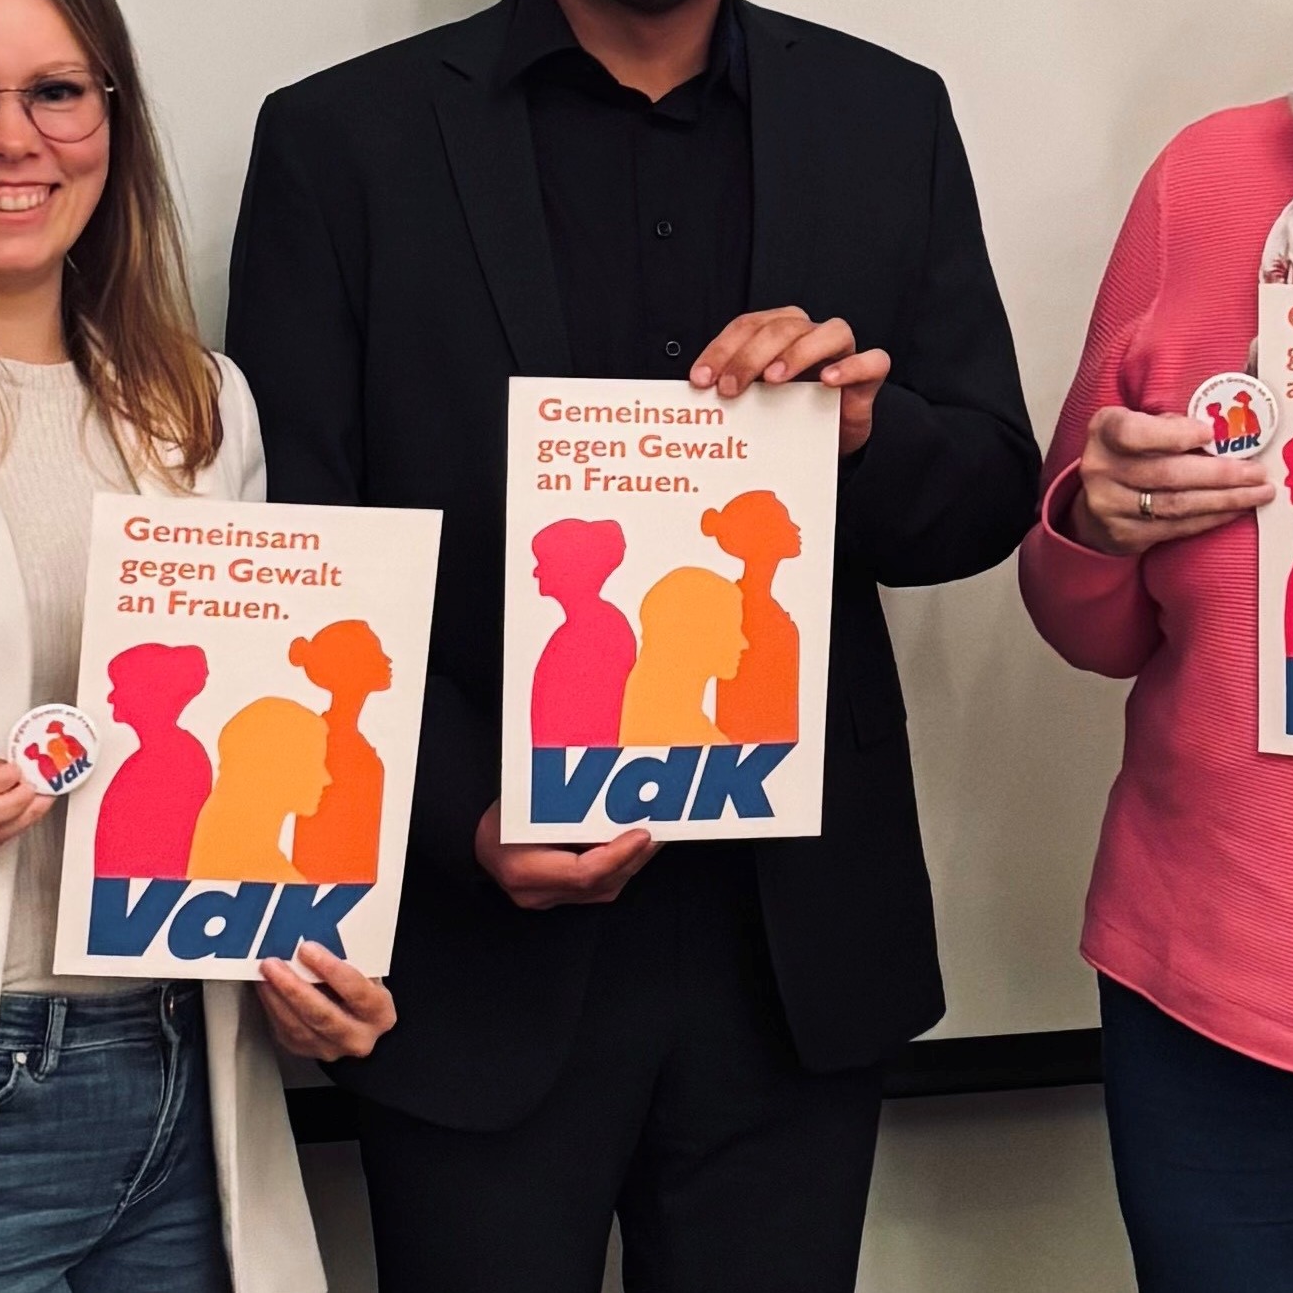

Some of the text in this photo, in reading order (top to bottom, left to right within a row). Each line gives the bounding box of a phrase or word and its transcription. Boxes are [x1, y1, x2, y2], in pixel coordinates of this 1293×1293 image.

[538, 398, 724, 425] Gemeinsam
[537, 435, 747, 463] gegen Gewalt
[1215, 435, 1260, 454] VdK
[537, 468, 699, 493] an Frauen.
[124, 517, 320, 550] Gemeinsam
[120, 559, 342, 587] gegen Gewalt
[117, 591, 290, 621] an Frauen.
[48, 753, 93, 792] VdK
[530, 743, 798, 824] VdK
[87, 877, 376, 960] VdK
